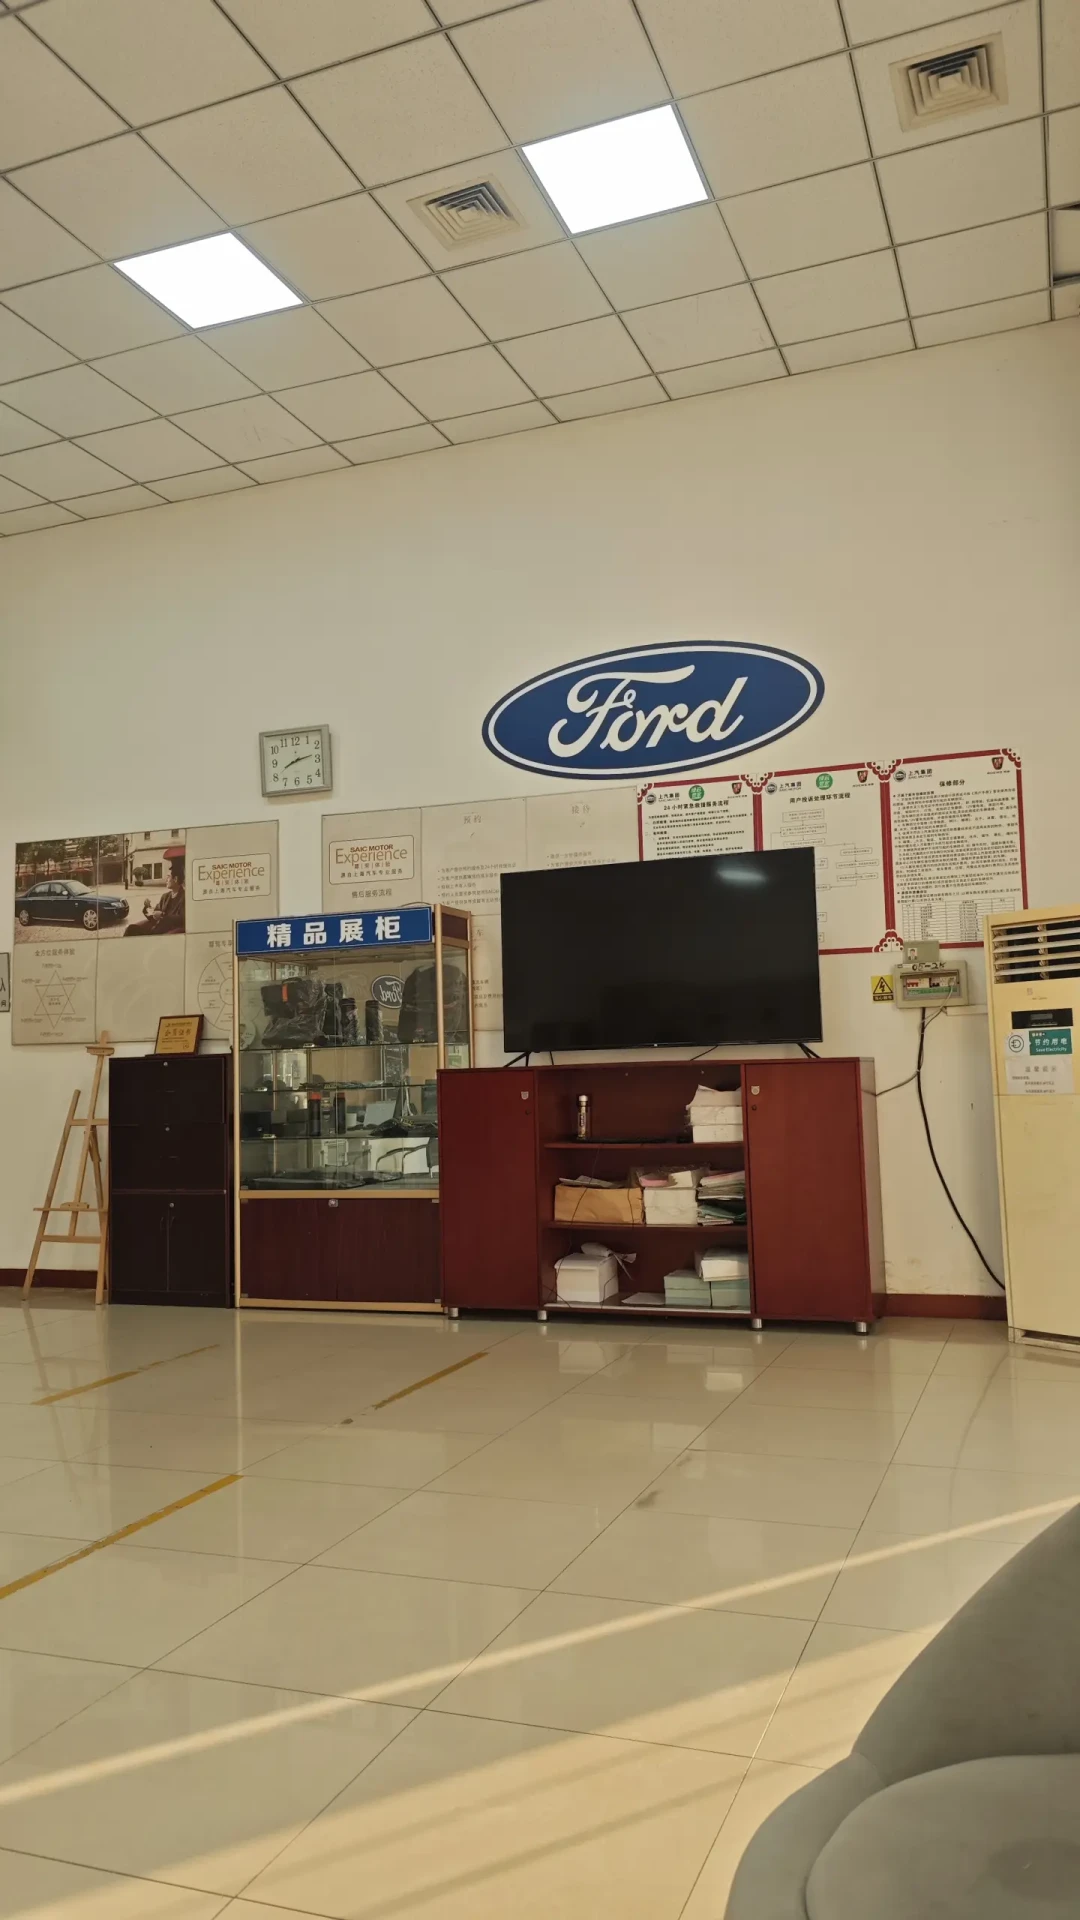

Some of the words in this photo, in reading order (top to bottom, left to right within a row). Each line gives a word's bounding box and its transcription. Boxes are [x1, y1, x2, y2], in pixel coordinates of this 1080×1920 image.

[548, 664, 748, 758] Ford
[280, 738, 288, 748] 11
[291, 736, 300, 746] 12
[305, 736, 309, 744] 1
[314, 740, 320, 750] 2
[271, 745, 279, 755] 10
[272, 759, 278, 768] 9
[314, 754, 320, 764] 3
[273, 773, 279, 782] 8
[315, 768, 320, 777] 4
[282, 778, 288, 786] 7
[294, 777, 300, 786] 6
[306, 775, 312, 784] 5
[939, 779, 965, 787] 保修部分
[790, 793, 851, 803] 用户投诉处理环节流程
[571, 804, 590, 814] 接待
[463, 814, 482, 824] 预约
[336, 848, 407, 866] Experience
[198, 865, 265, 883] Experience
[352, 888, 392, 898] 售后服务流程
[266, 916, 401, 948] 精品展柜
[35, 948, 75, 957] 全方位服务体验
[1035, 1038, 1068, 1046] 节约用电
